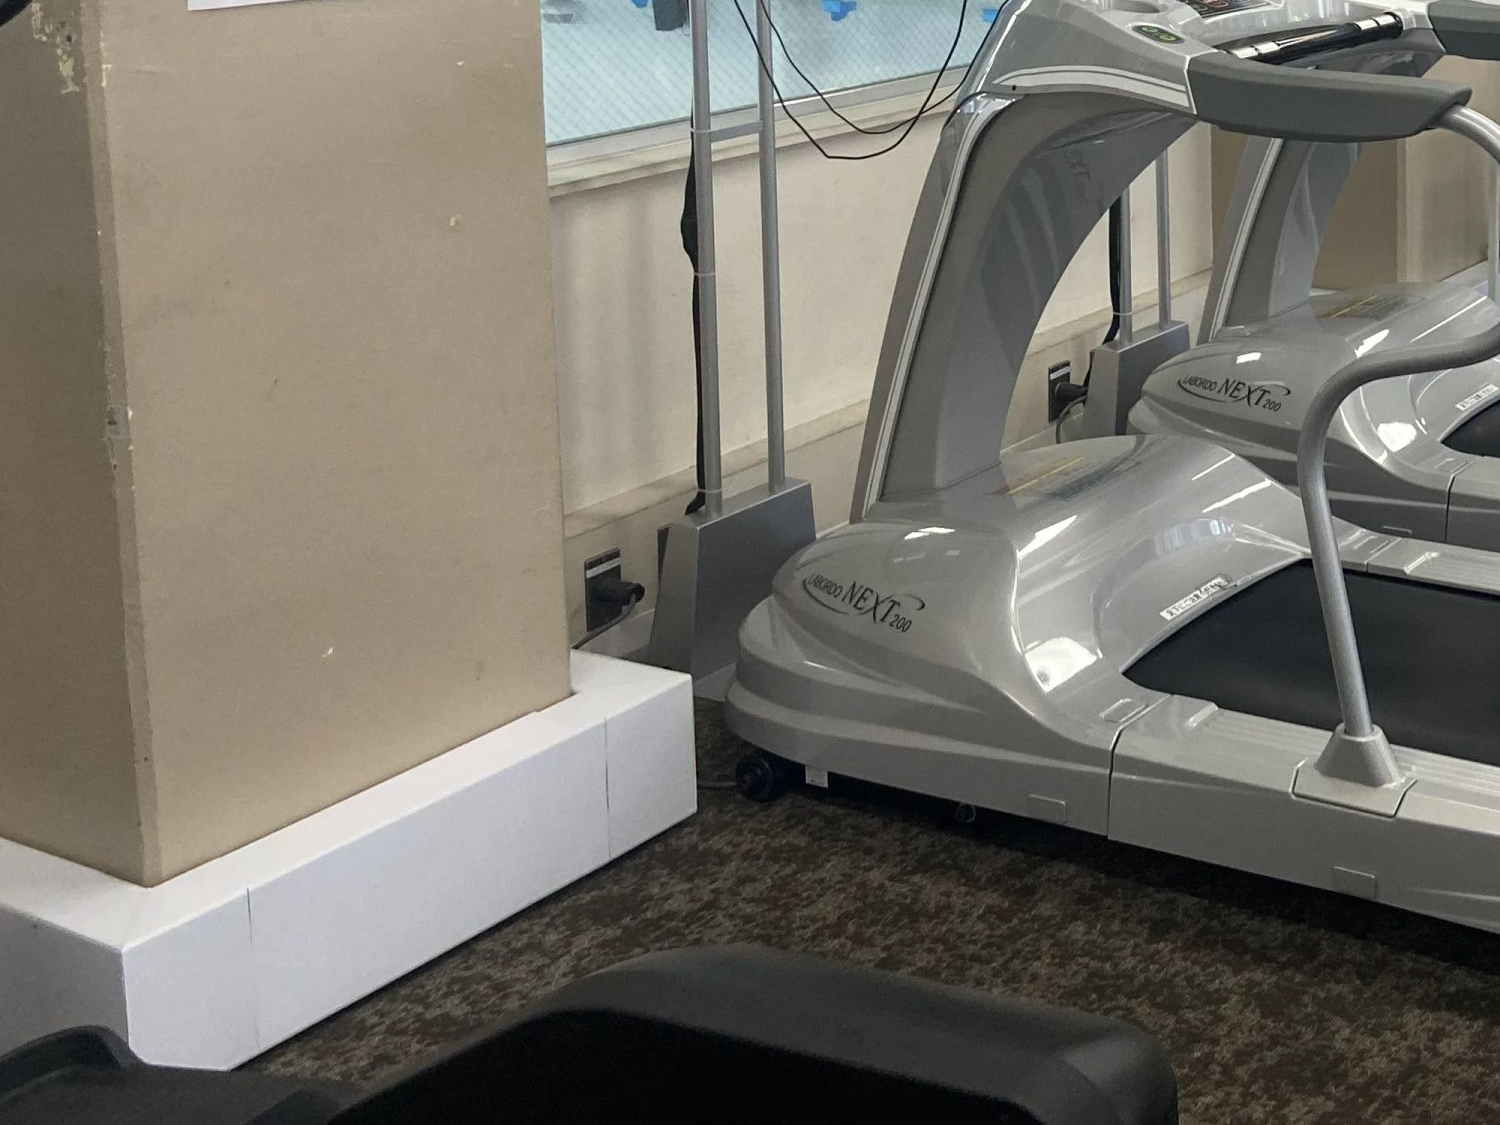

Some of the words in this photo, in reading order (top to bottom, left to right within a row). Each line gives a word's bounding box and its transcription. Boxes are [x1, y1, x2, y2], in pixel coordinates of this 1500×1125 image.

[1217, 378, 1271, 407] NEXT
[1262, 398, 1282, 412] 200
[841, 580, 901, 623] NEXT
[889, 613, 912, 633] 200
